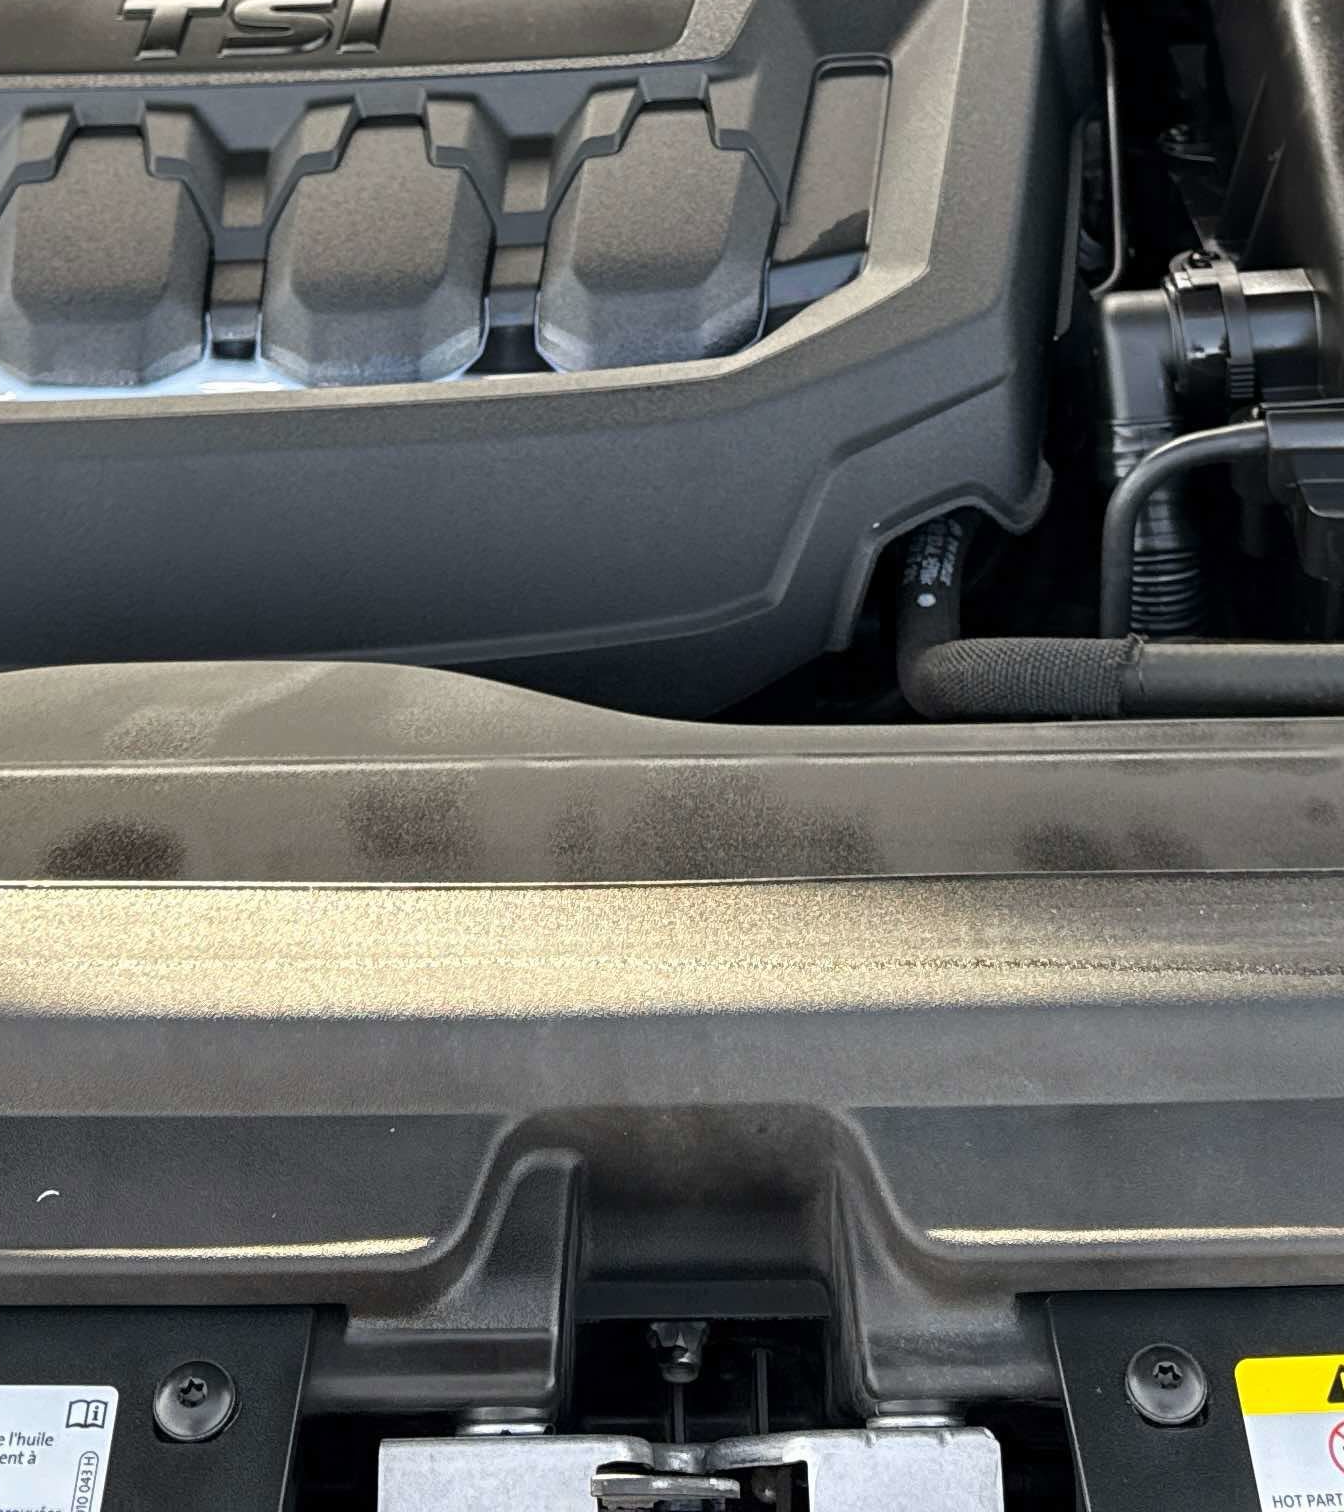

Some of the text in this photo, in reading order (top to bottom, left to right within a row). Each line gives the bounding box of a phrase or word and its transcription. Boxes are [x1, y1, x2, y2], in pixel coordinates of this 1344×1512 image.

[8, 1431, 55, 1447] l'huile
[27, 1450, 37, 1465] à
[1272, 1494, 1302, 1509] HOT
